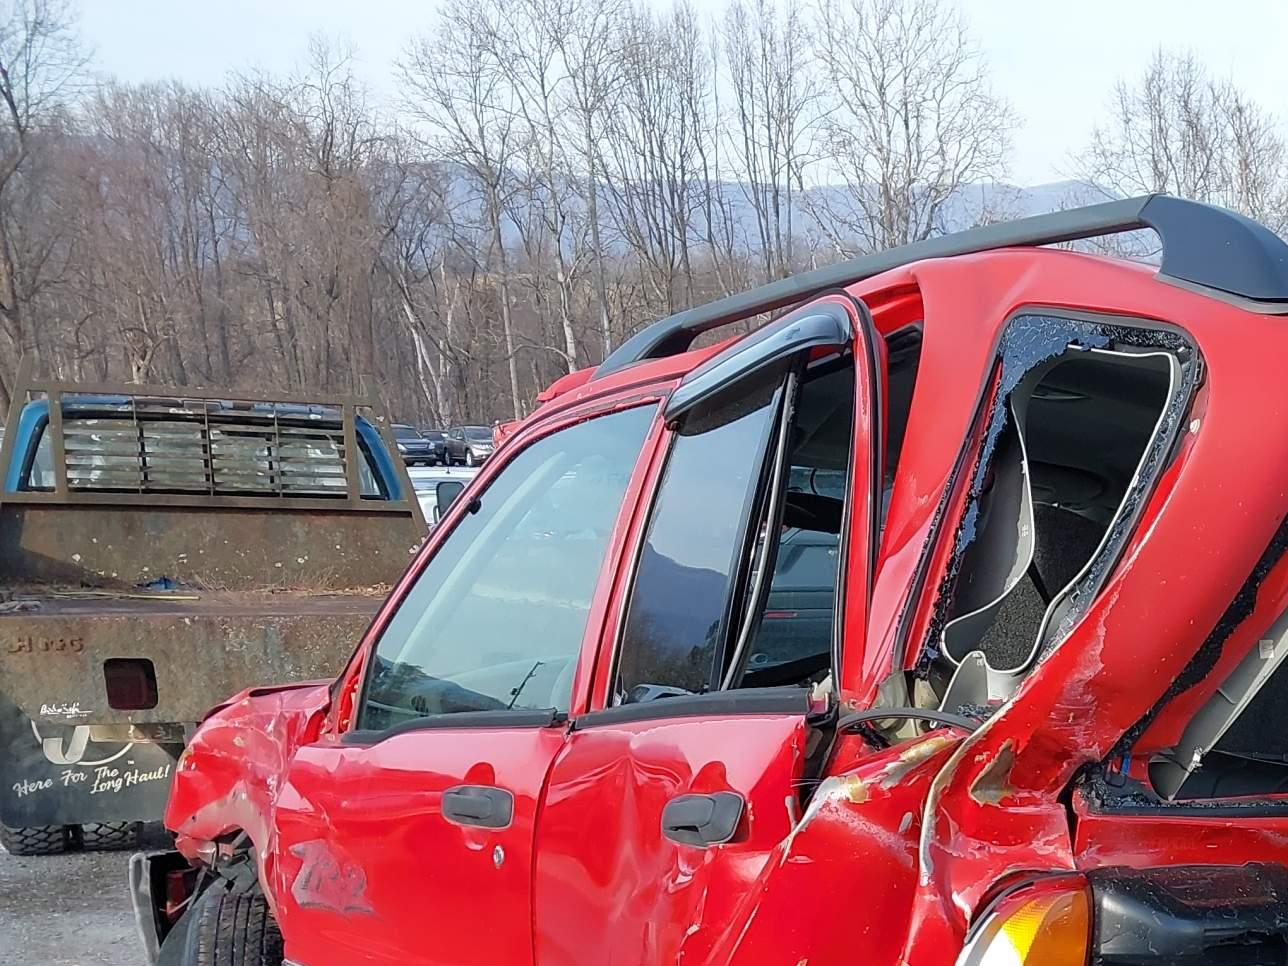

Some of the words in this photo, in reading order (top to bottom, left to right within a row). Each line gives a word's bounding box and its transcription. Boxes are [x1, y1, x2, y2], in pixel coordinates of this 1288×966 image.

[12, 777, 53, 799] Here
[60, 769, 88, 787] For
[95, 766, 120, 781] The
[90, 777, 123, 795] Long
[124, 764, 171, 788] Haul!
